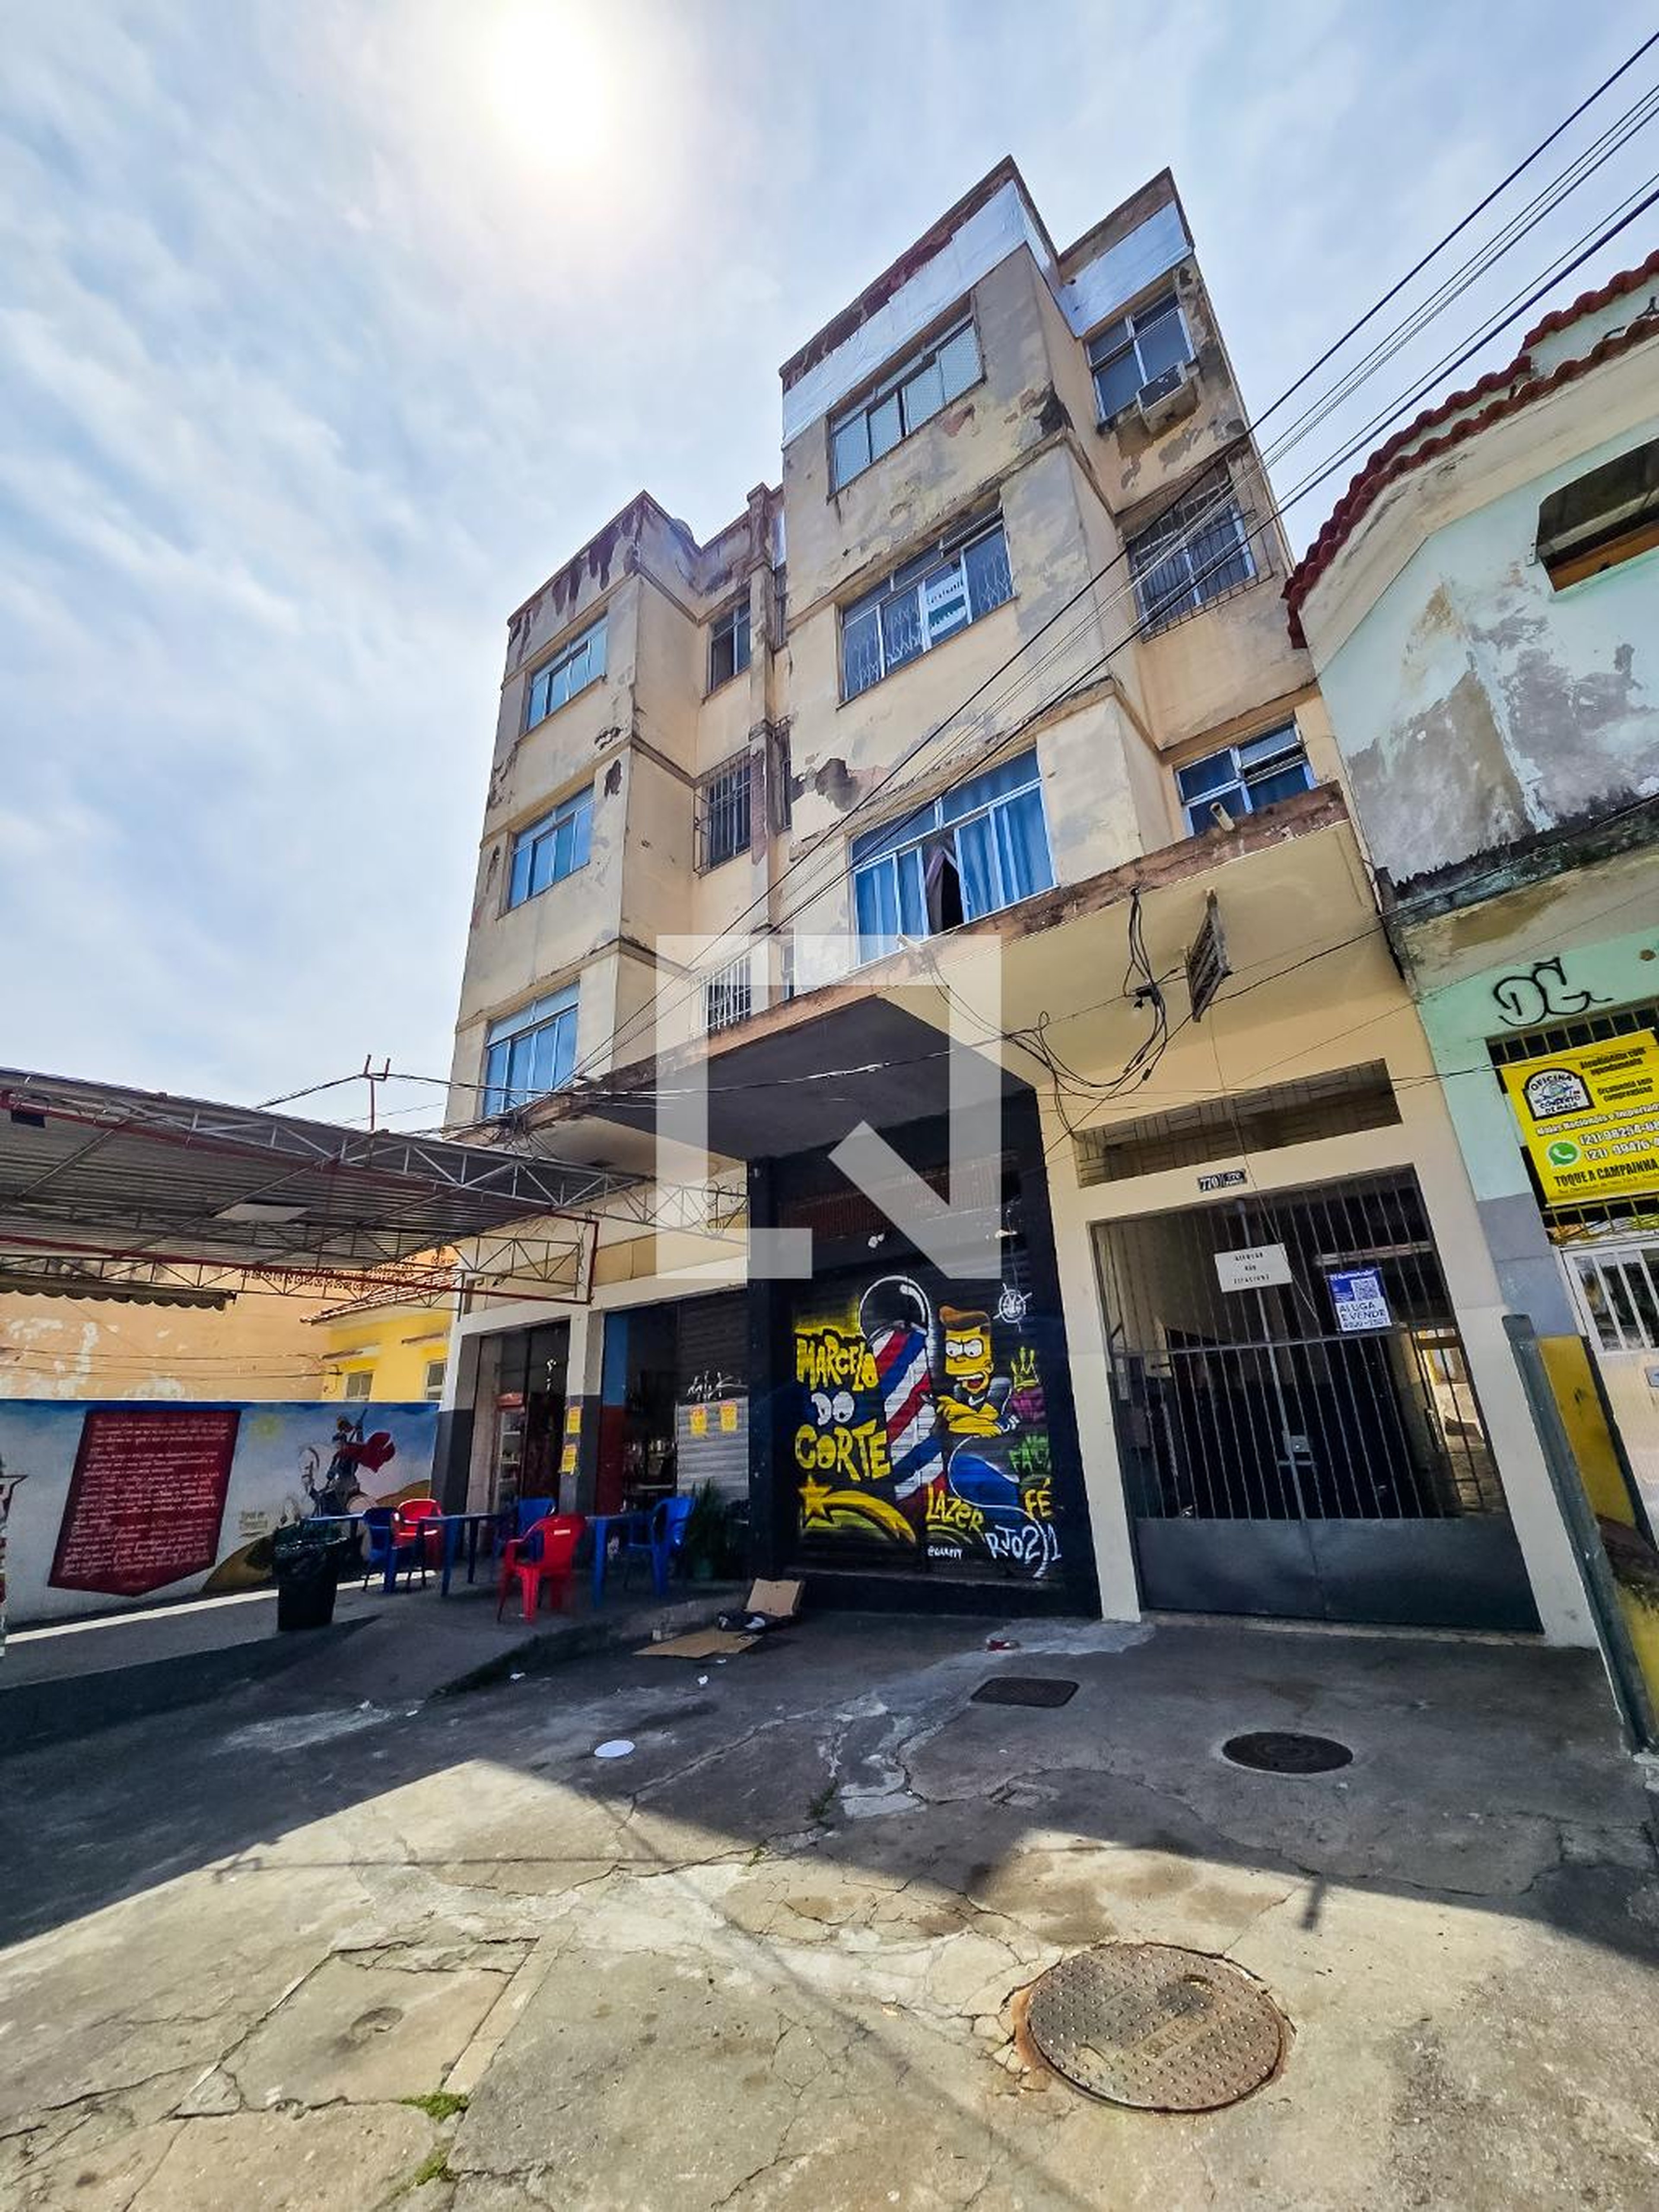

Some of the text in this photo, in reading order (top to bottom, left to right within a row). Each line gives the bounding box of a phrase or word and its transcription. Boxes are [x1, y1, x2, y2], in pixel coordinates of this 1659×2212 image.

[1531, 1075, 1573, 1091] OFICINA
[1554, 1171, 1588, 1187] TOQUE
[1588, 1170, 1597, 1182] A
[1340, 1302, 1375, 1312] ALUGA
[1350, 1308, 1386, 1320] VENDE
[796, 1334, 878, 1392] MARCELO
[811, 1391, 855, 1425] DO
[795, 1418, 891, 1482] CORTE
